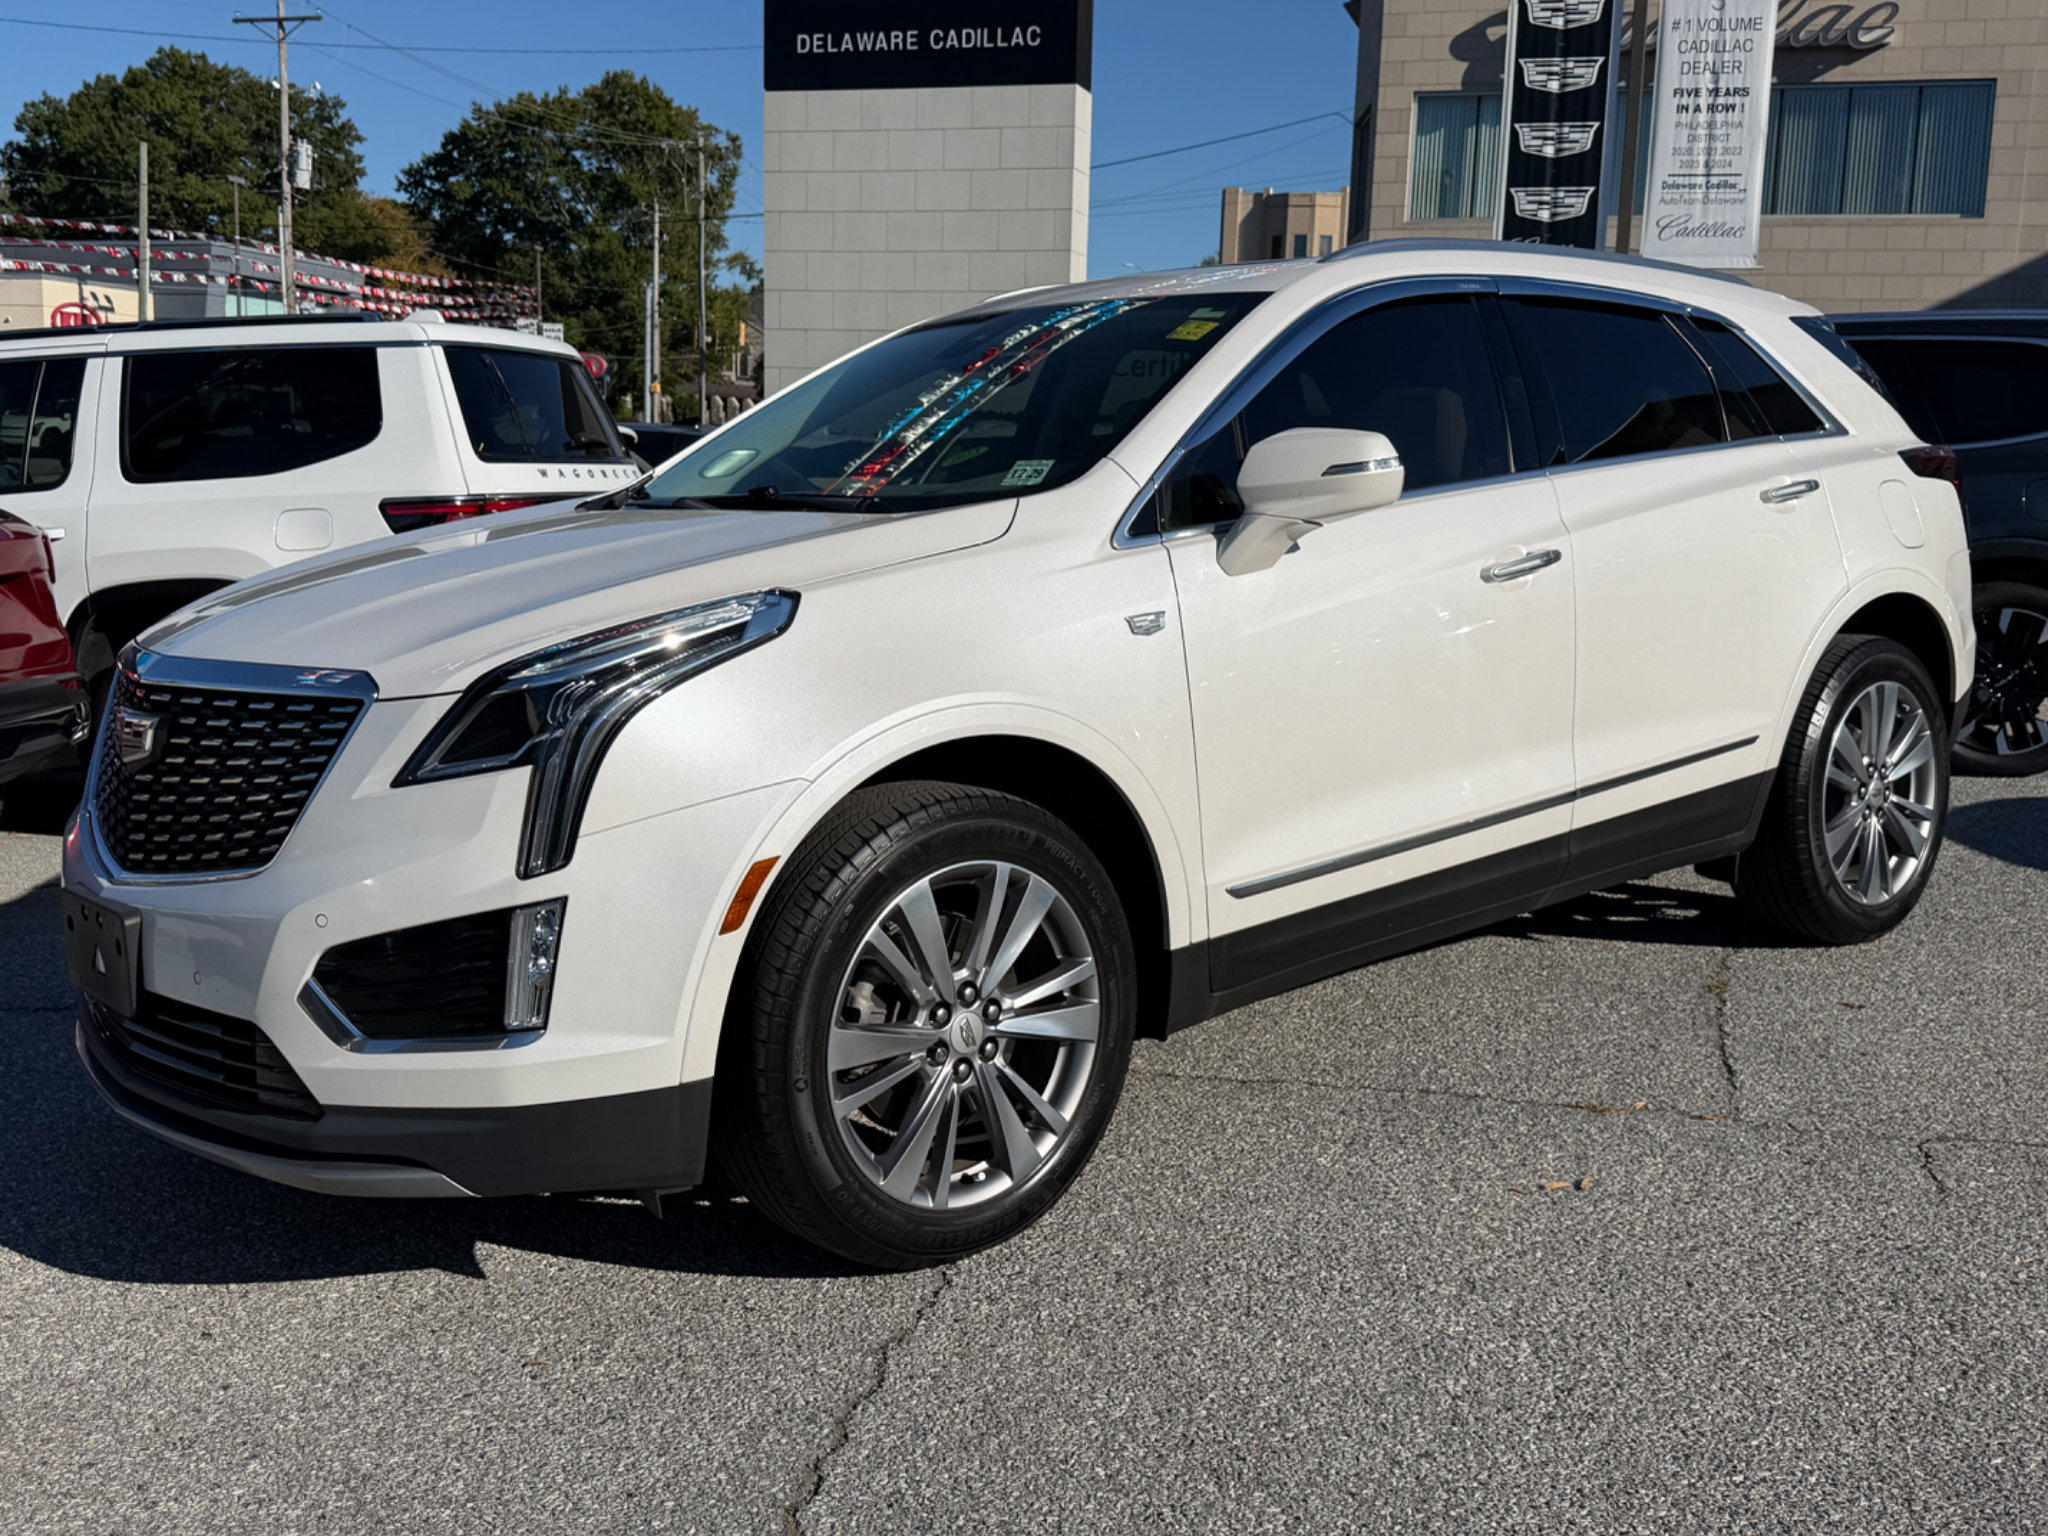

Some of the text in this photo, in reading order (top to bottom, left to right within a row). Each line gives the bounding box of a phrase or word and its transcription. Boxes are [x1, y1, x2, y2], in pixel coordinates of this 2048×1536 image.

[1697, 16, 1764, 32] VOLUME
[796, 26, 1042, 54] DELAWARE CADILLAC
[1677, 38, 1754, 54] CADILLAC
[1680, 60, 1743, 75] DEALER
[1672, 87, 1751, 98] FIVE YEARS
[1676, 104, 1689, 114] IN
[1693, 103, 1702, 114] A
[1706, 103, 1737, 114] ROW
[1674, 120, 1744, 130] PHILADELPHIA
[1687, 133, 1731, 143] DISTRICT
[1661, 180, 1738, 190] Delaware Cadillac
[1656, 213, 1746, 241] Cadillac
[1044, 839, 1088, 880] PRIMACY
